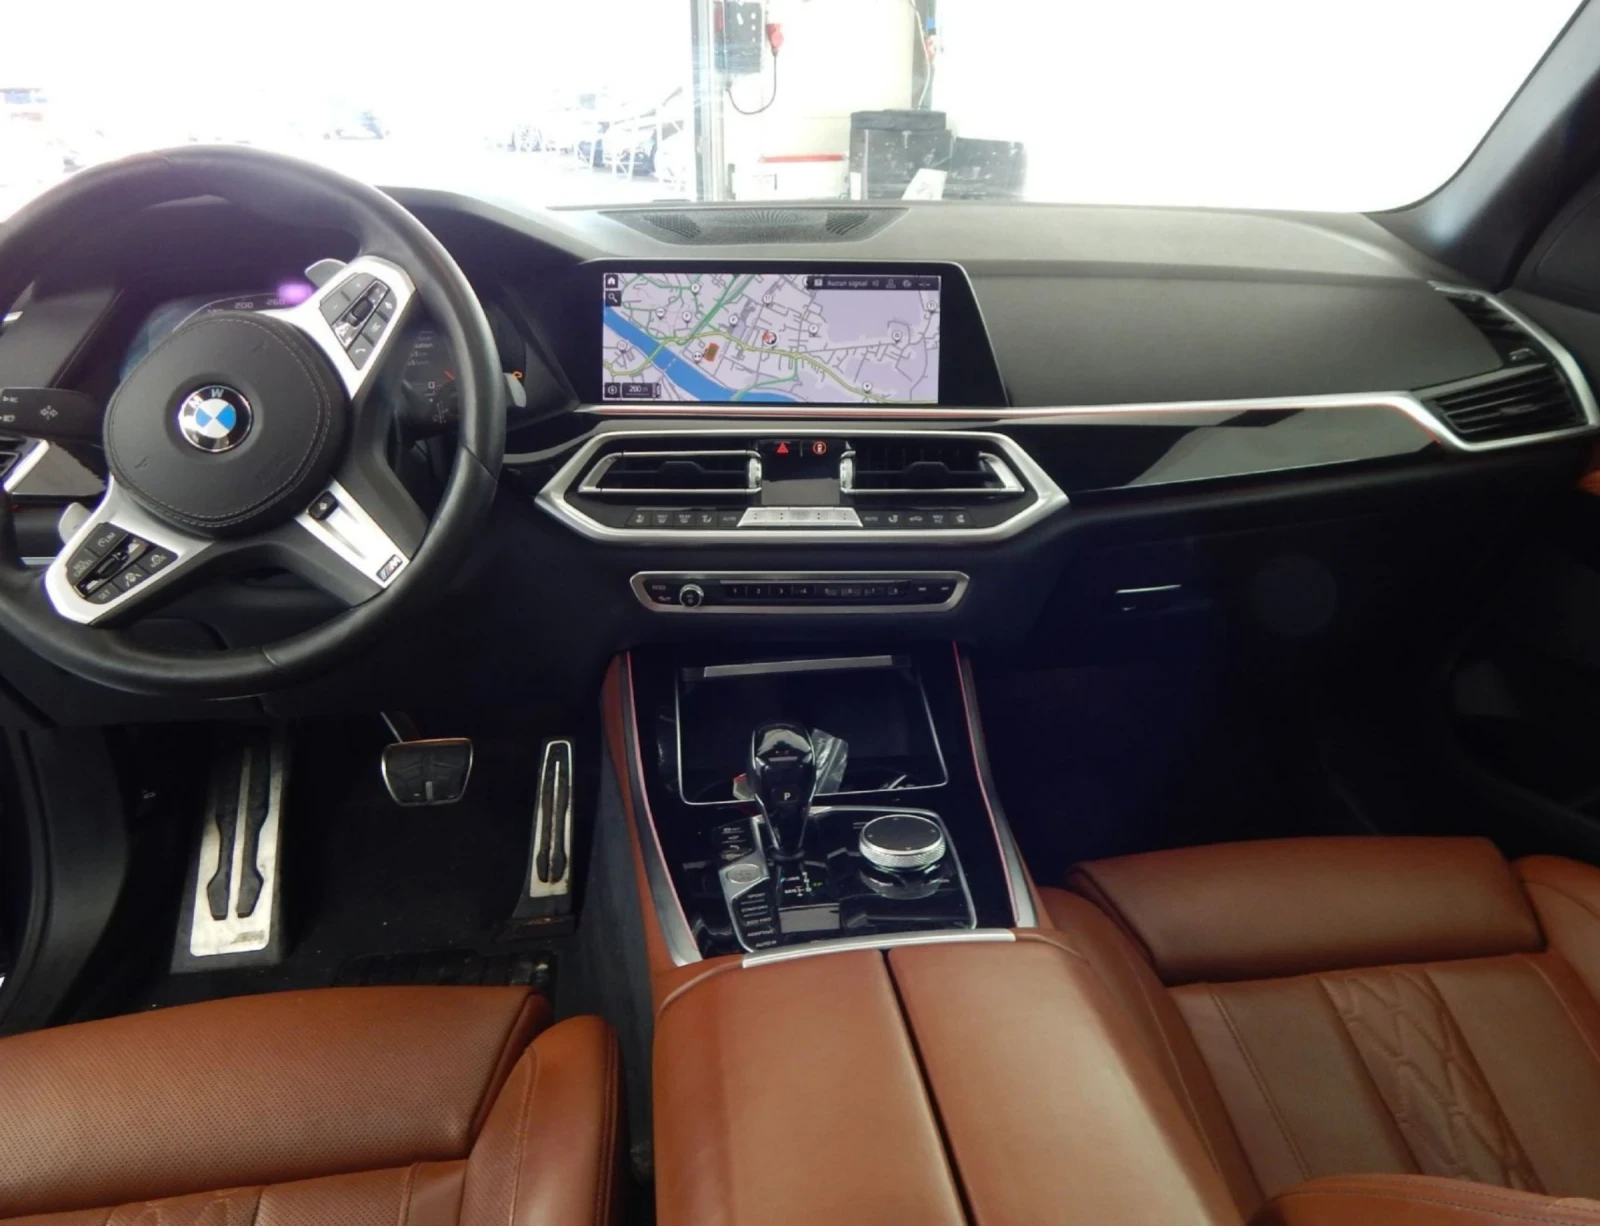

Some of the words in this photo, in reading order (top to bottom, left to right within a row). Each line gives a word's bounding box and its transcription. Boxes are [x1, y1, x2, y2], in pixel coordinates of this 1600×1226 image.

[234, 301, 254, 309] 200
[628, 385, 641, 393] 200
[783, 792, 791, 801] P
